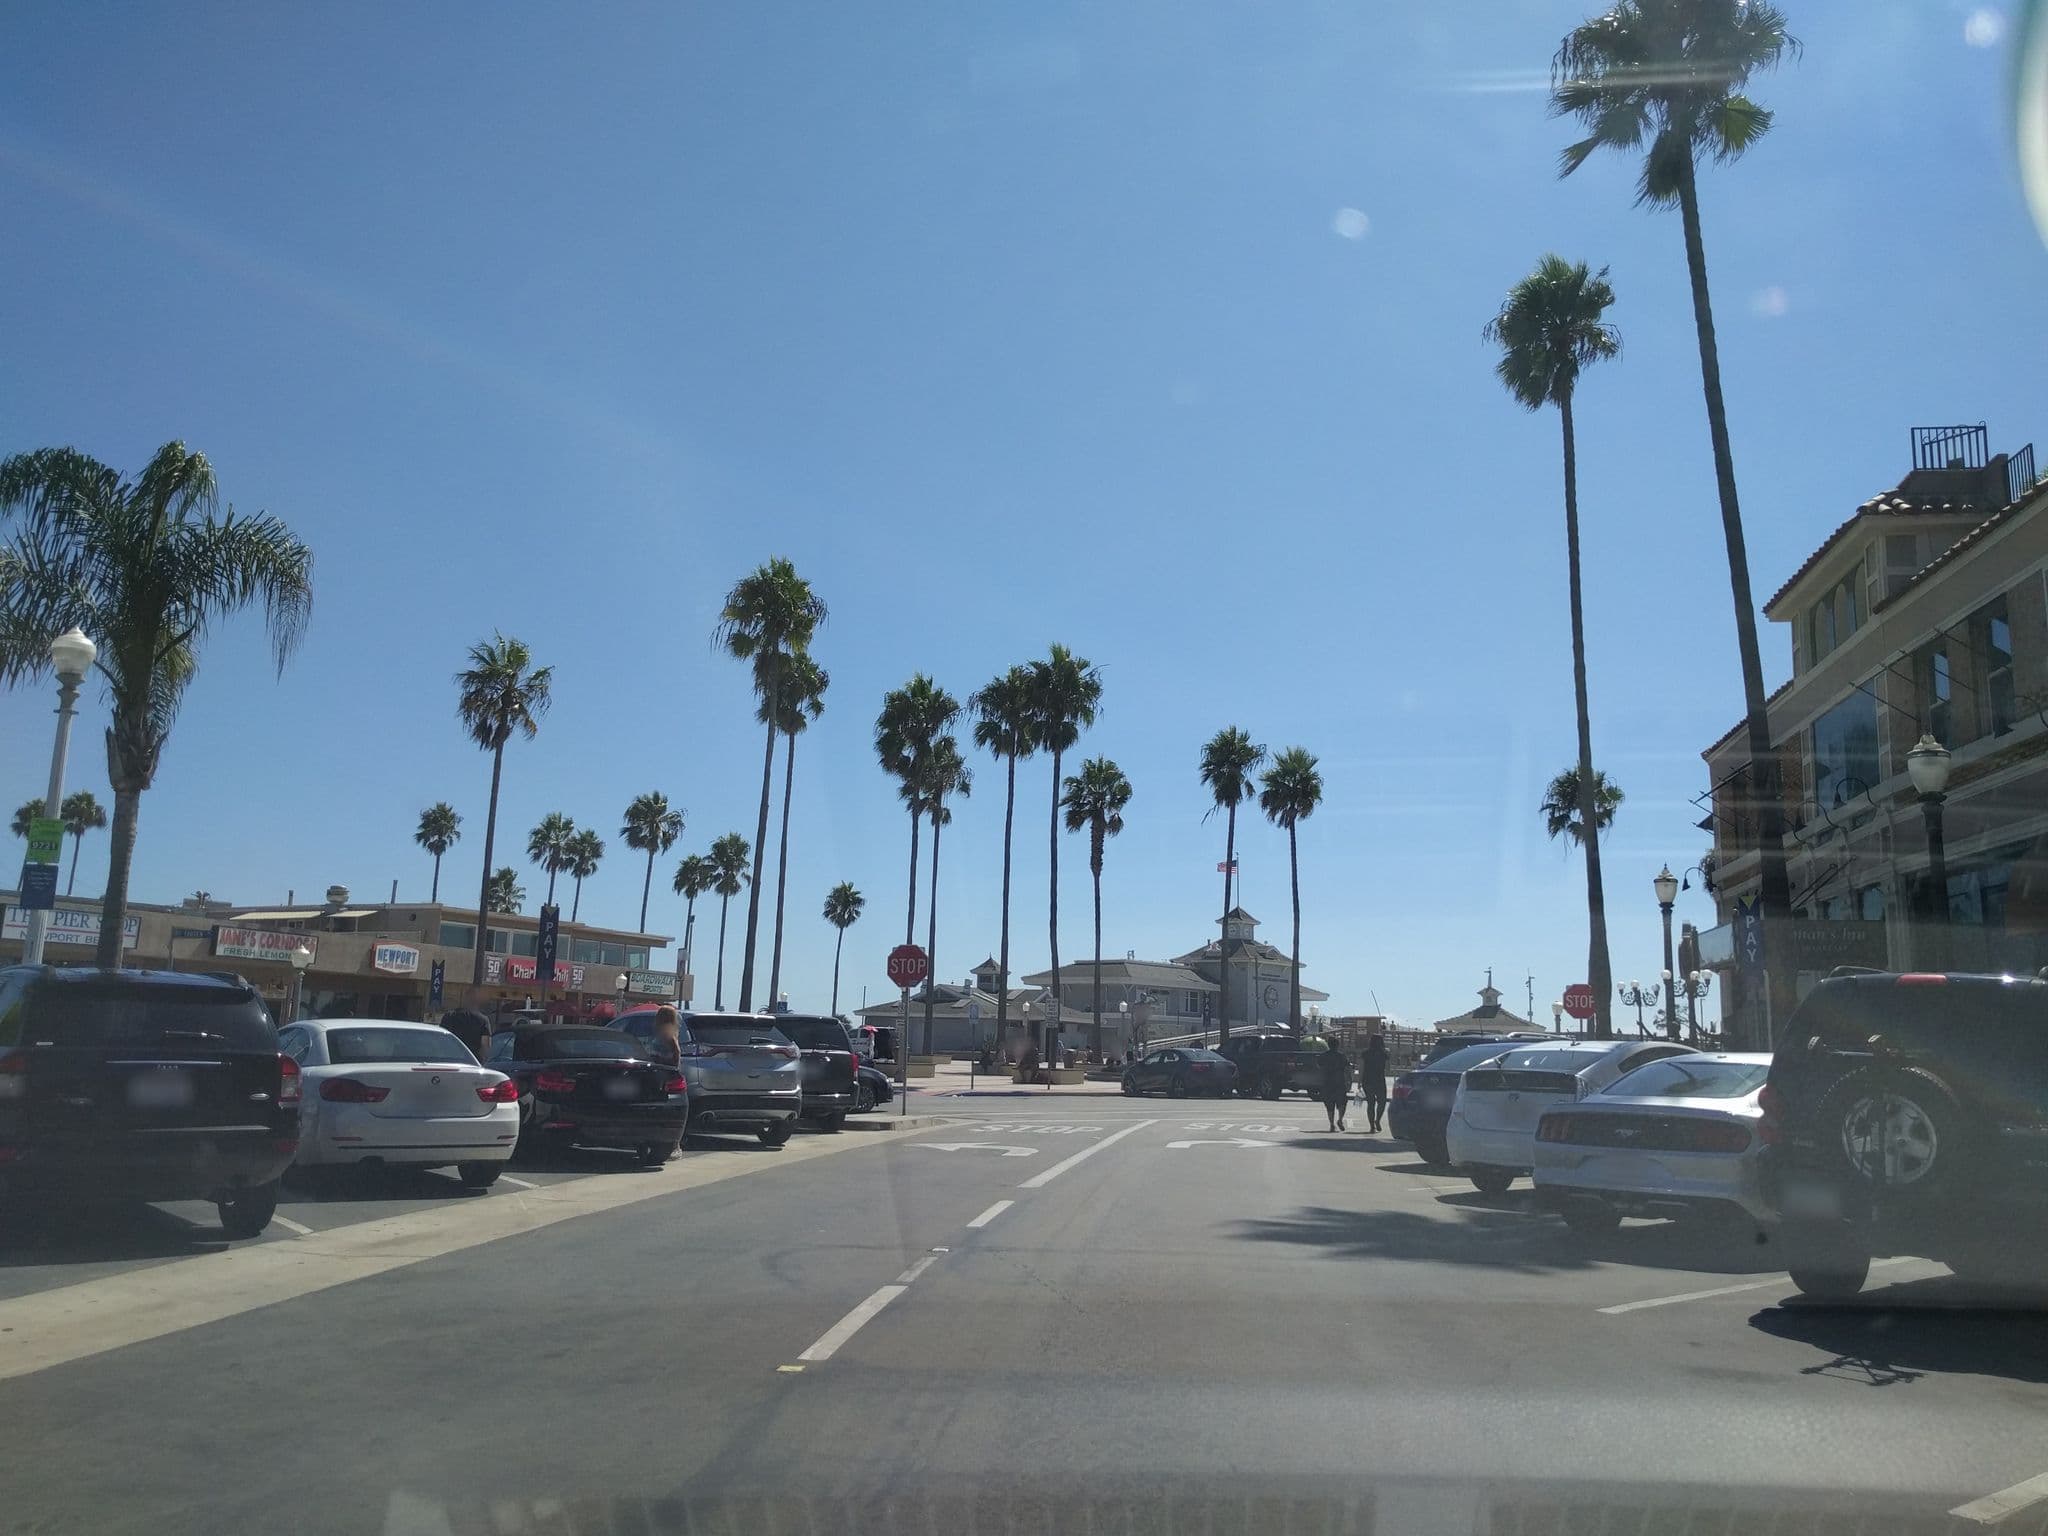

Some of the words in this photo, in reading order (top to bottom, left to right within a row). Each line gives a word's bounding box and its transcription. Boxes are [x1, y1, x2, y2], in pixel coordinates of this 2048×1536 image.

[53, 910, 91, 929] PIER
[96, 913, 138, 932] SOP
[20, 930, 82, 943] NPORT
[543, 921, 554, 959] PAY
[1746, 915, 1757, 962] PAY
[223, 947, 256, 957] FRESH
[259, 950, 292, 960] LEMON
[377, 948, 417, 966] NEWPORT
[487, 960, 500, 973] 50
[890, 959, 926, 974] STOP
[433, 968, 441, 993] PAY
[553, 968, 569, 983] hili
[572, 969, 583, 981] 50
[630, 973, 673, 987] BOARDWALK
[643, 984, 664, 993] SPORTS
[968, 1124, 1104, 1134] STOP
[1181, 1122, 1300, 1133] STOP
